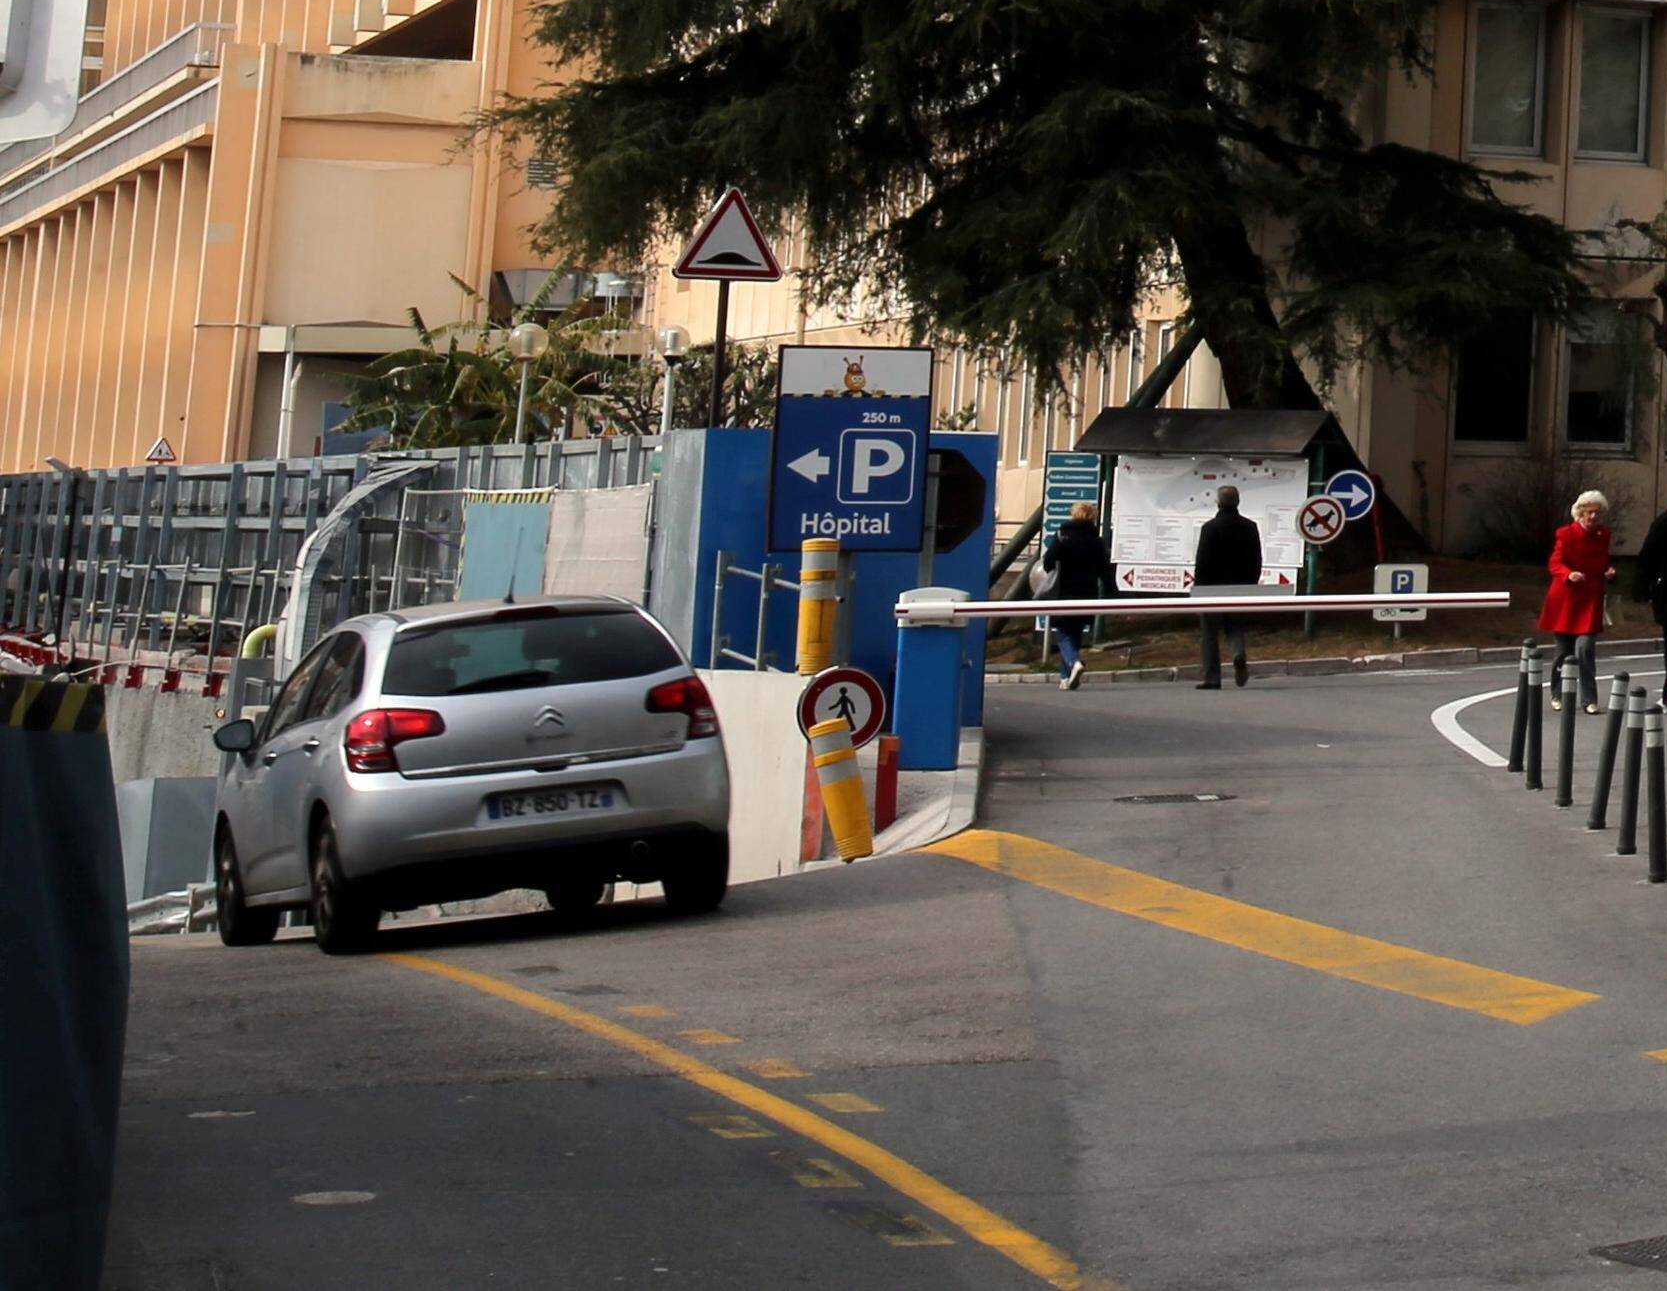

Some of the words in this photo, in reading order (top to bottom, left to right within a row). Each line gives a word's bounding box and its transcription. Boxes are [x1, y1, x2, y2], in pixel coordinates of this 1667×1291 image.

[862, 412, 887, 423] 250
[889, 415, 901, 423] m
[852, 438, 905, 493] P
[801, 512, 891, 540] Hôpital
[1396, 573, 1410, 591] P
